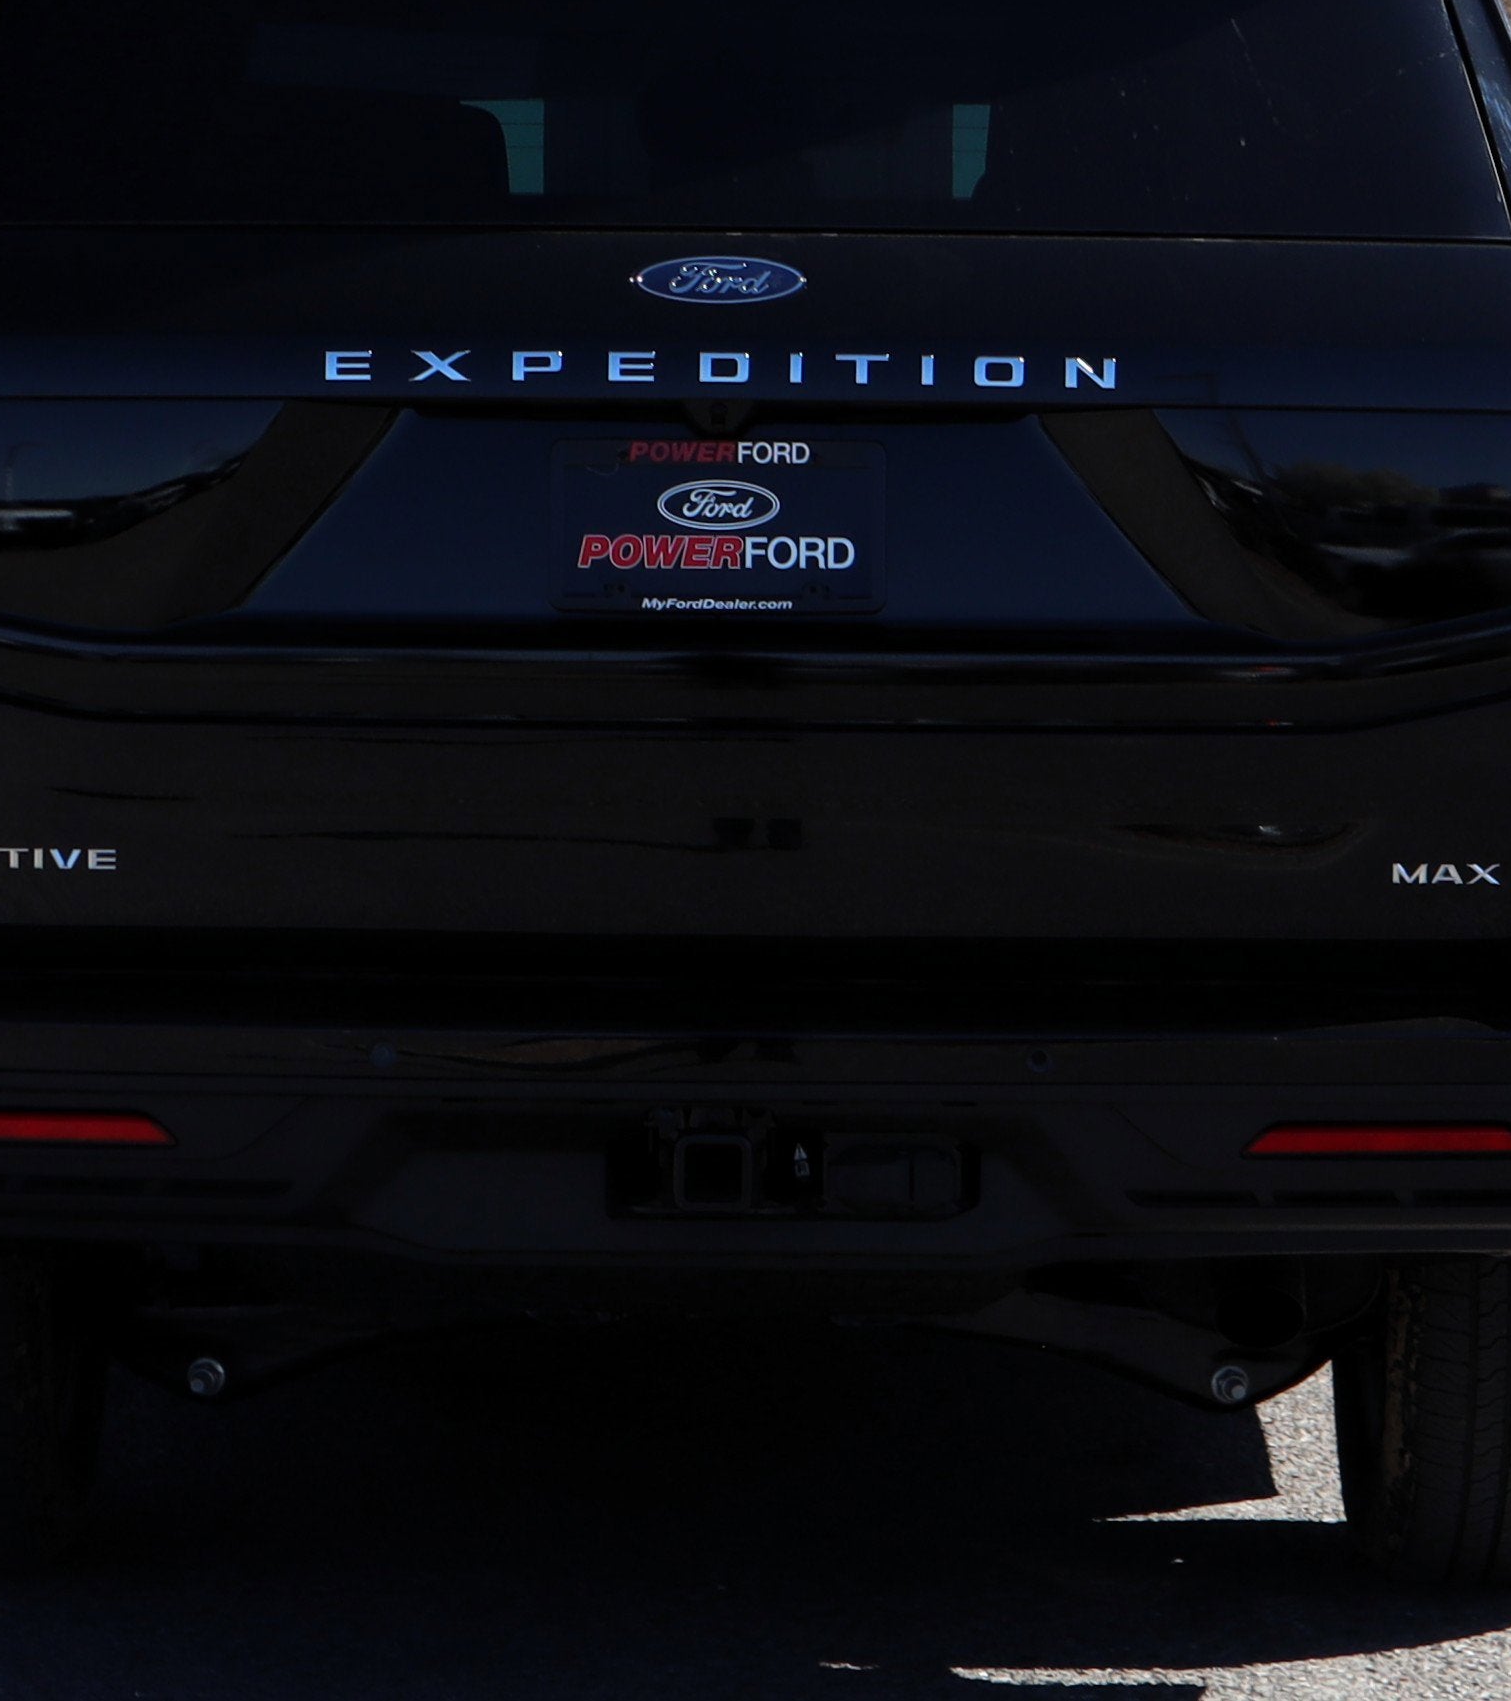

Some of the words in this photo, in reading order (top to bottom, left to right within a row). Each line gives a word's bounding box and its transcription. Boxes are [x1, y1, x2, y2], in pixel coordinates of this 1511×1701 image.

[669, 262, 771, 296] Ford
[324, 350, 1117, 389] EXPEDITION
[682, 488, 754, 519] Ford
[641, 597, 793, 611] MyFordDealer.com
[1392, 862, 1501, 885] MAX
